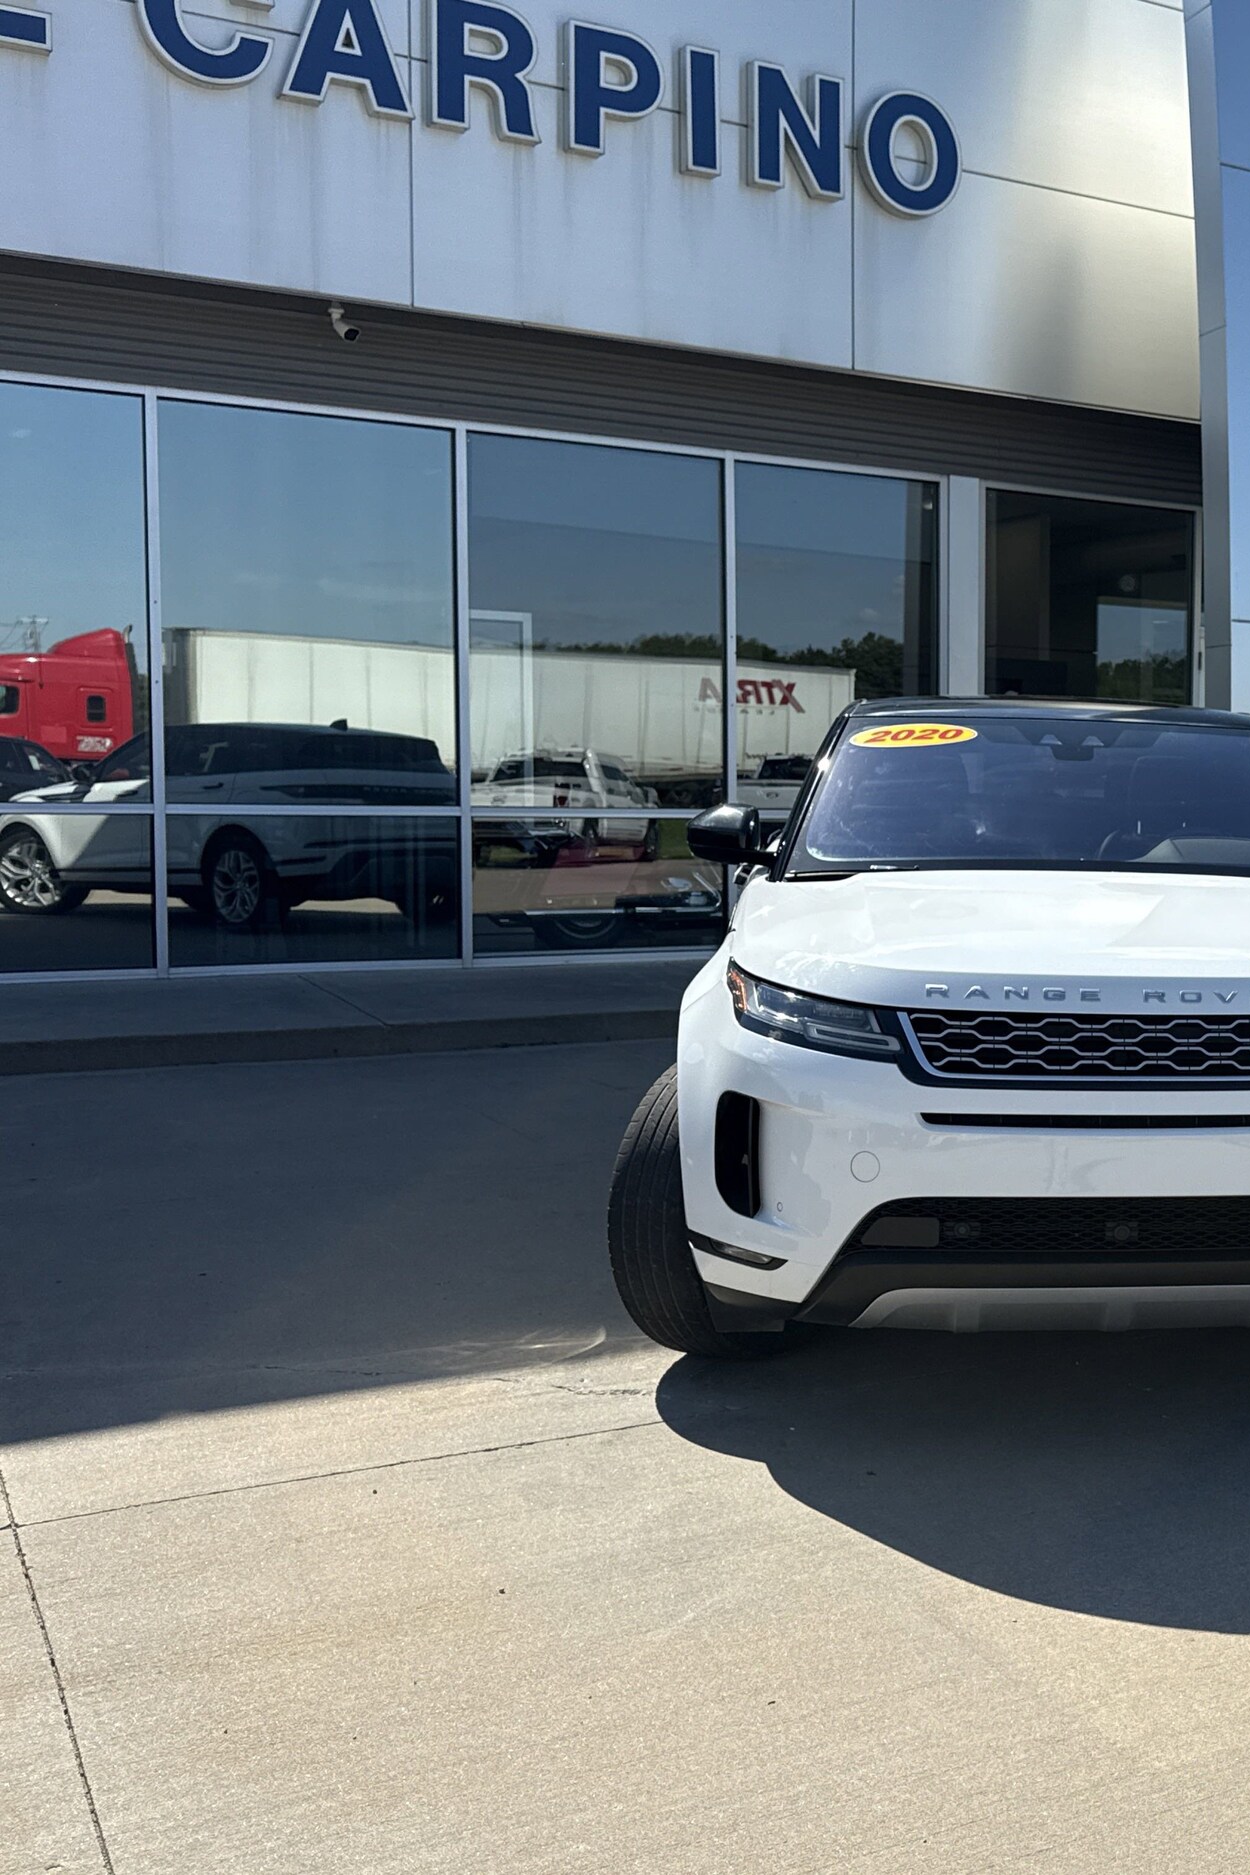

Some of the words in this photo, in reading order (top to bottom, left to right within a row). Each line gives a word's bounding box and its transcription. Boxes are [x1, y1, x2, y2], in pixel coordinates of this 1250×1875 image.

[137, 0, 963, 220] CARPINO
[863, 729, 964, 743] 2020
[925, 983, 1101, 1002] RANGE
